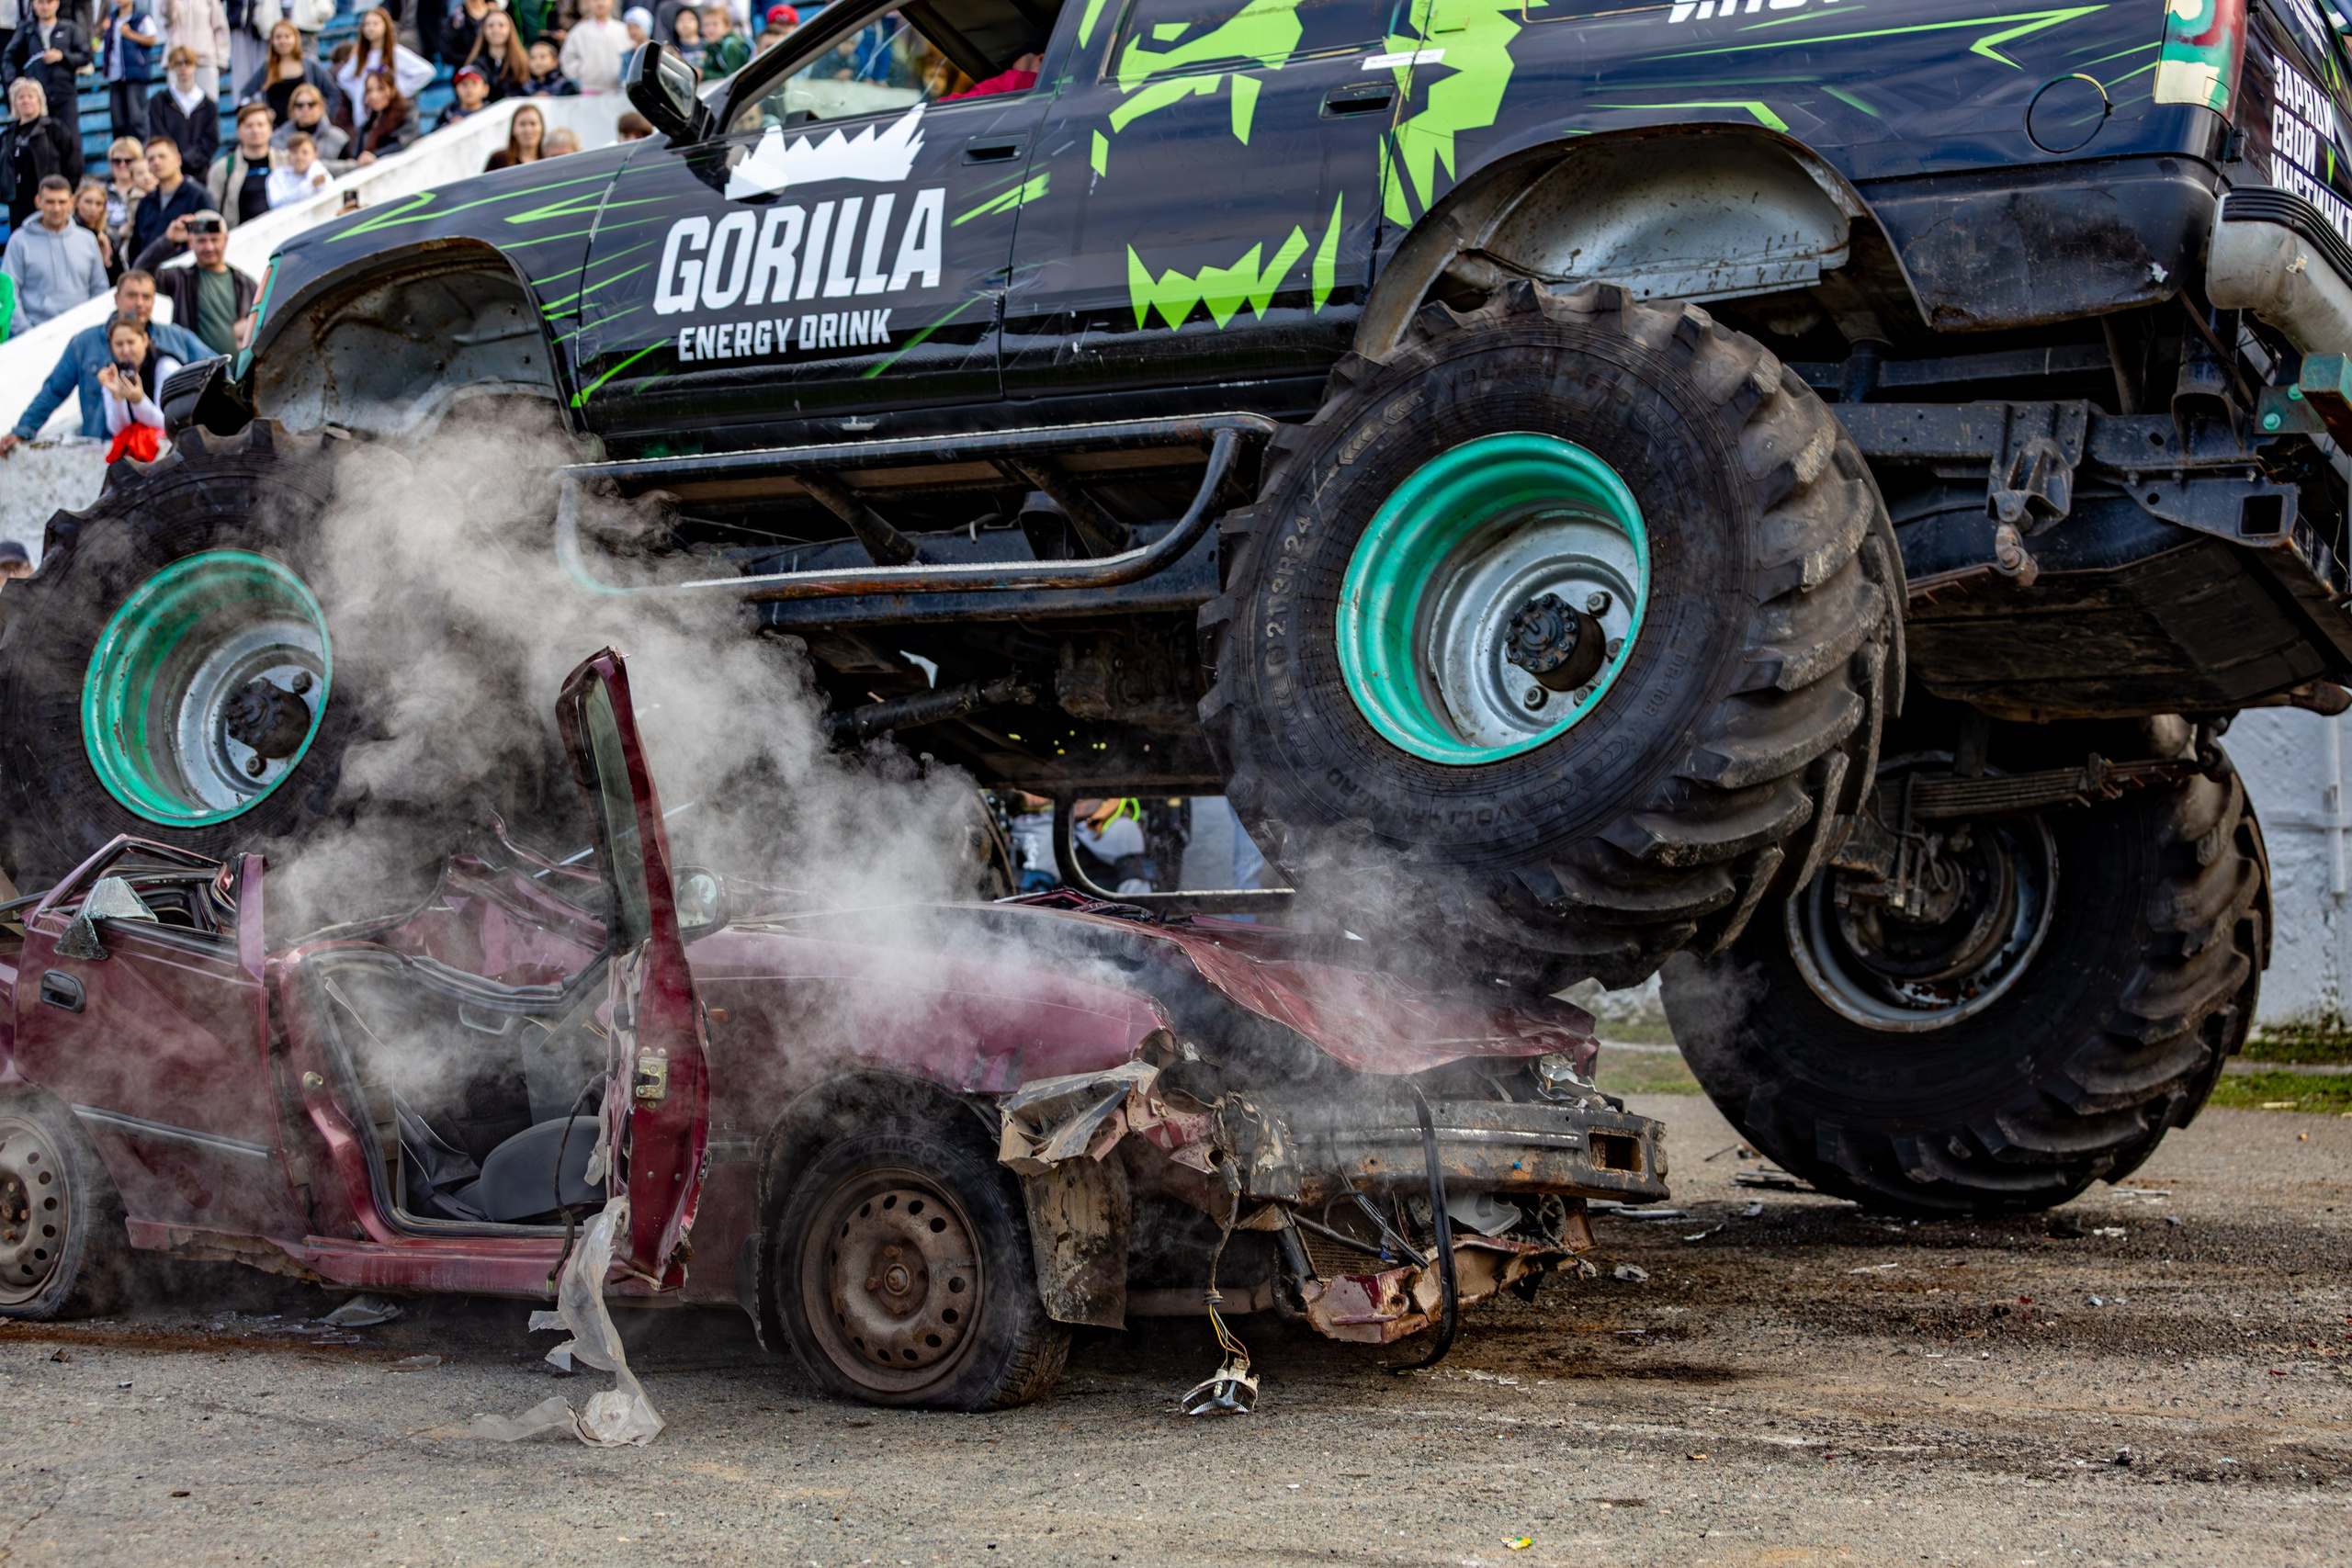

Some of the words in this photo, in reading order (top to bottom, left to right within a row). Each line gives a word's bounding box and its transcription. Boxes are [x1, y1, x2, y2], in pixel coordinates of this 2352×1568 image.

[2273, 54, 2335, 143] ЗАРЯДИ
[2272, 104, 2316, 176] СВОЙ
[652, 186, 946, 315] GORILLA
[678, 318, 794, 362] ENERGY
[797, 308, 892, 351] DRINK
